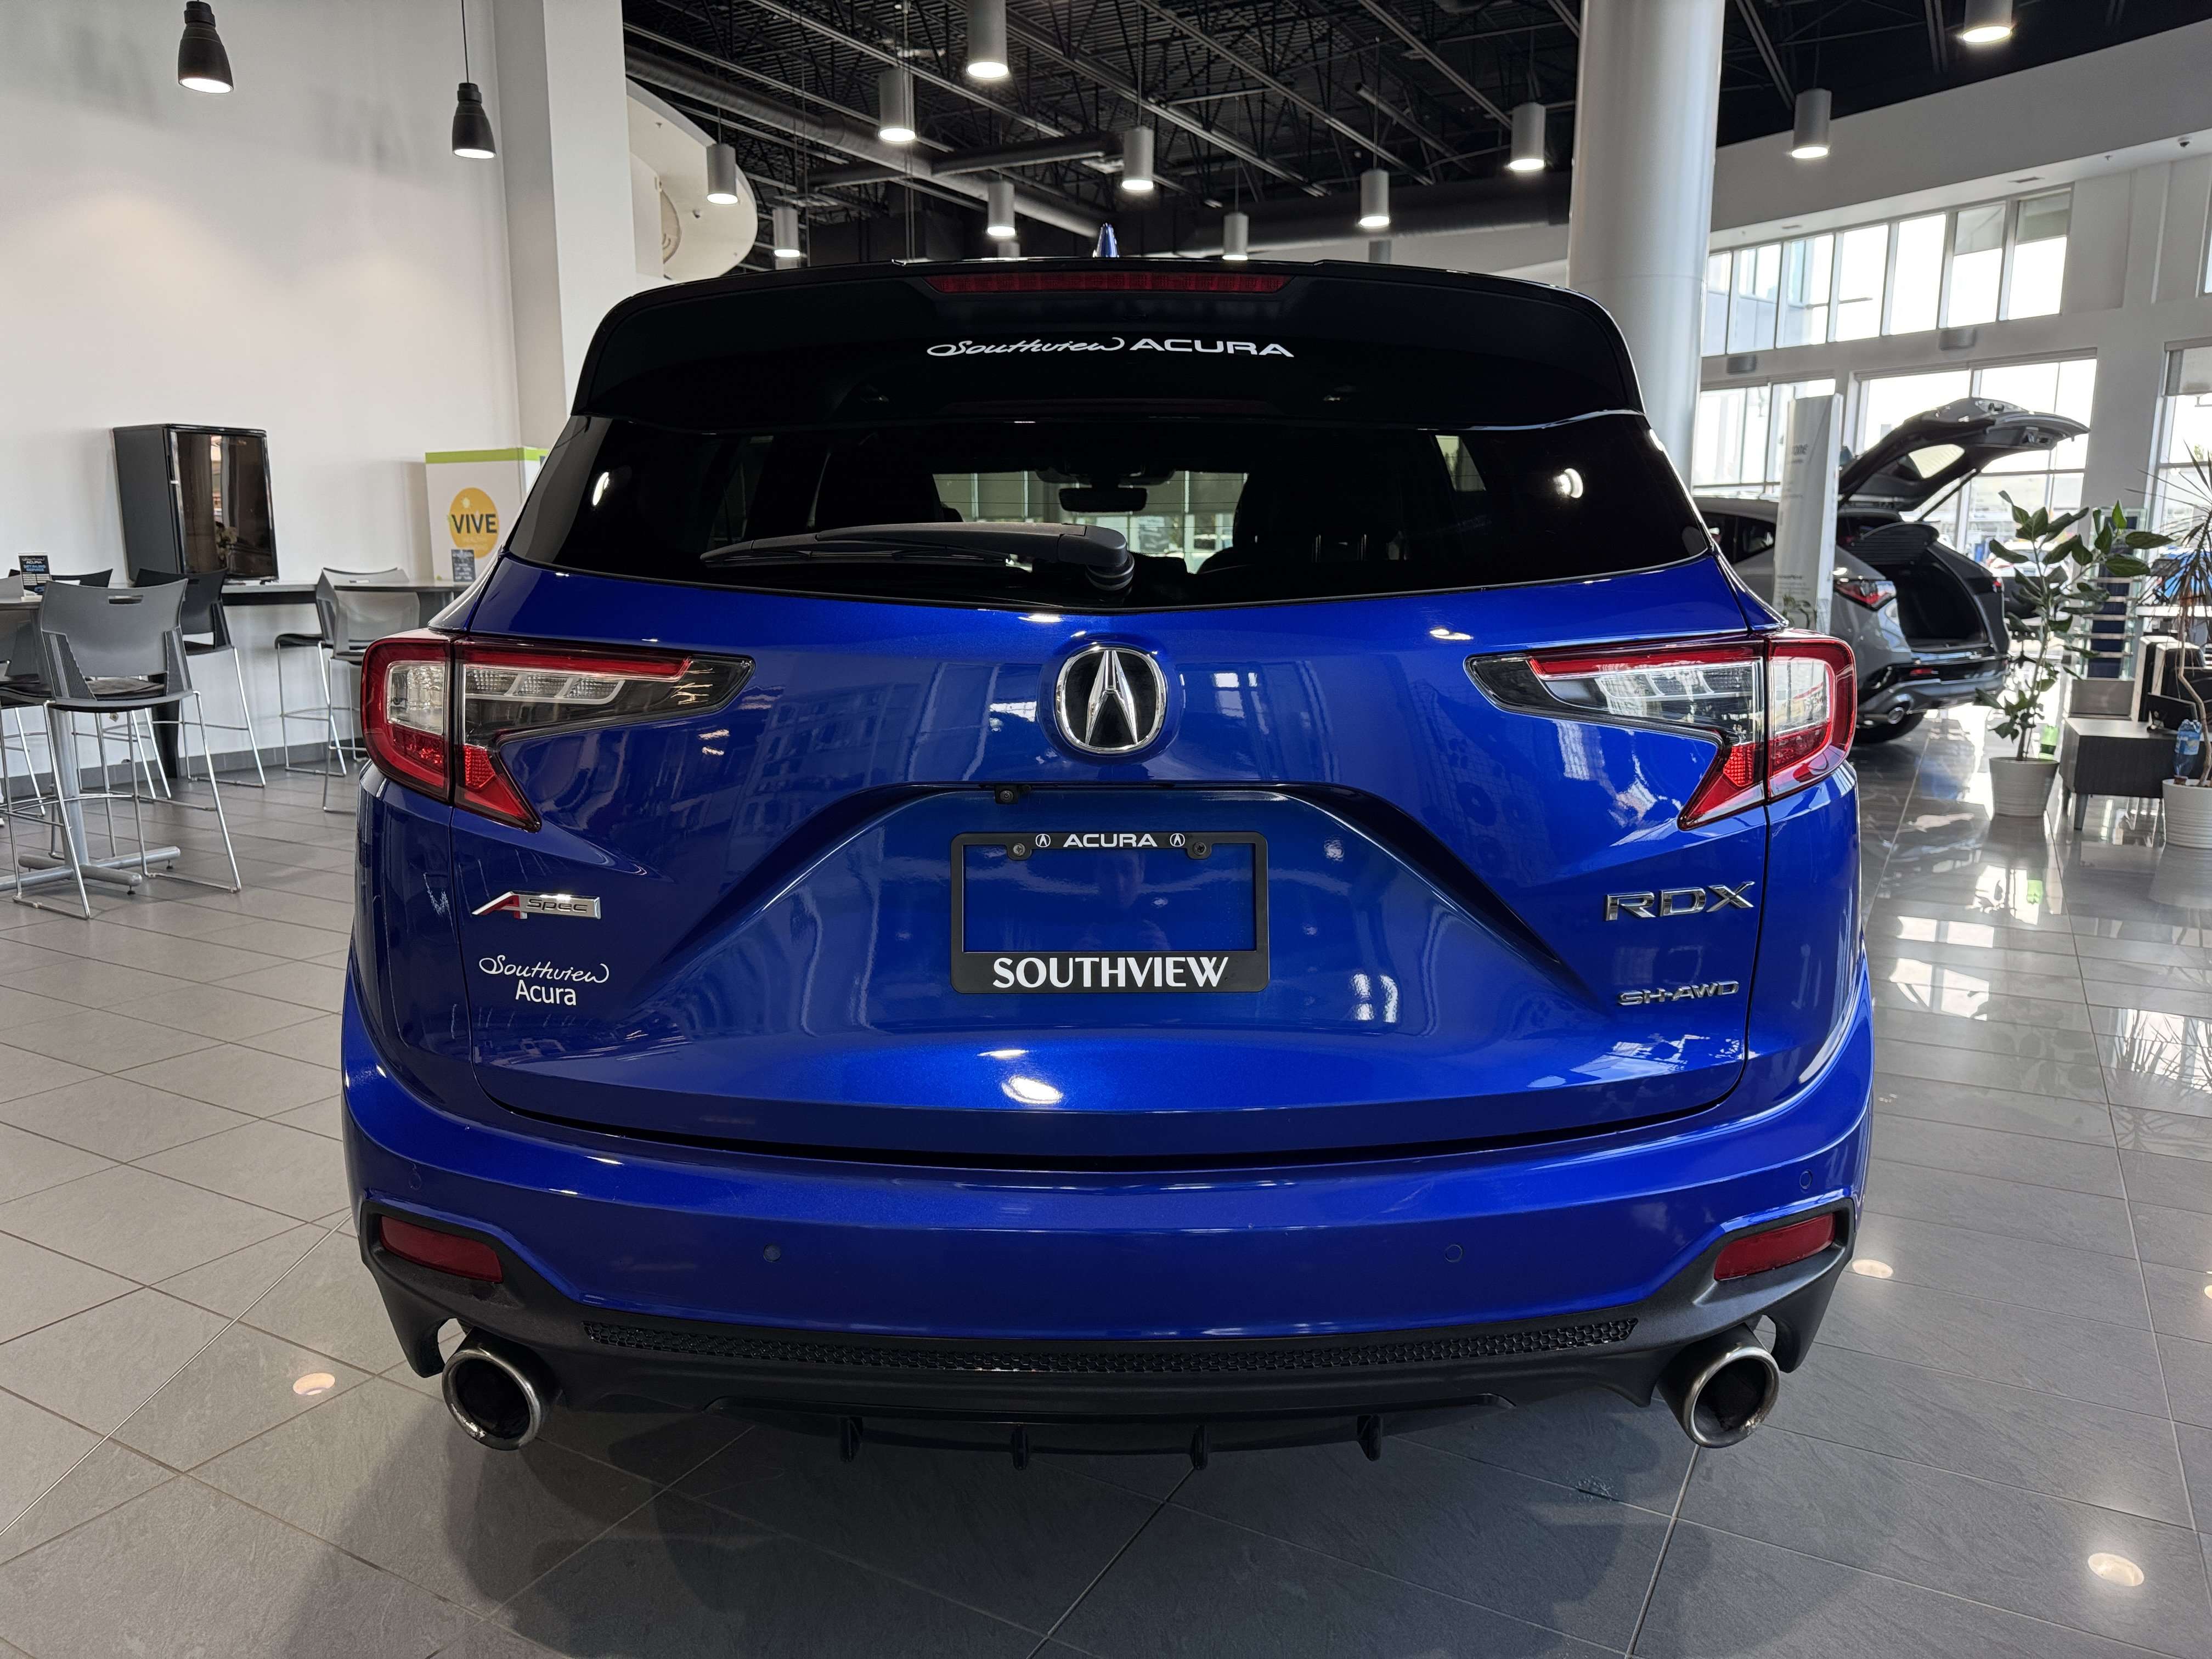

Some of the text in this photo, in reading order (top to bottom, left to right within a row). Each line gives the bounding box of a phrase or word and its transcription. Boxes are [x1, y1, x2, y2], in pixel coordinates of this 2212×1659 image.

[927, 337, 1294, 358] Southview ACURA
[451, 514, 498, 534] VIVE
[1063, 833, 1158, 848] ACURA
[1605, 881, 1756, 921] RDX
[479, 955, 610, 984] Southview
[992, 956, 1229, 988] SOUTHVIEW
[515, 979, 577, 1006] Acura
[1618, 980, 1740, 1006] SH-AWD
